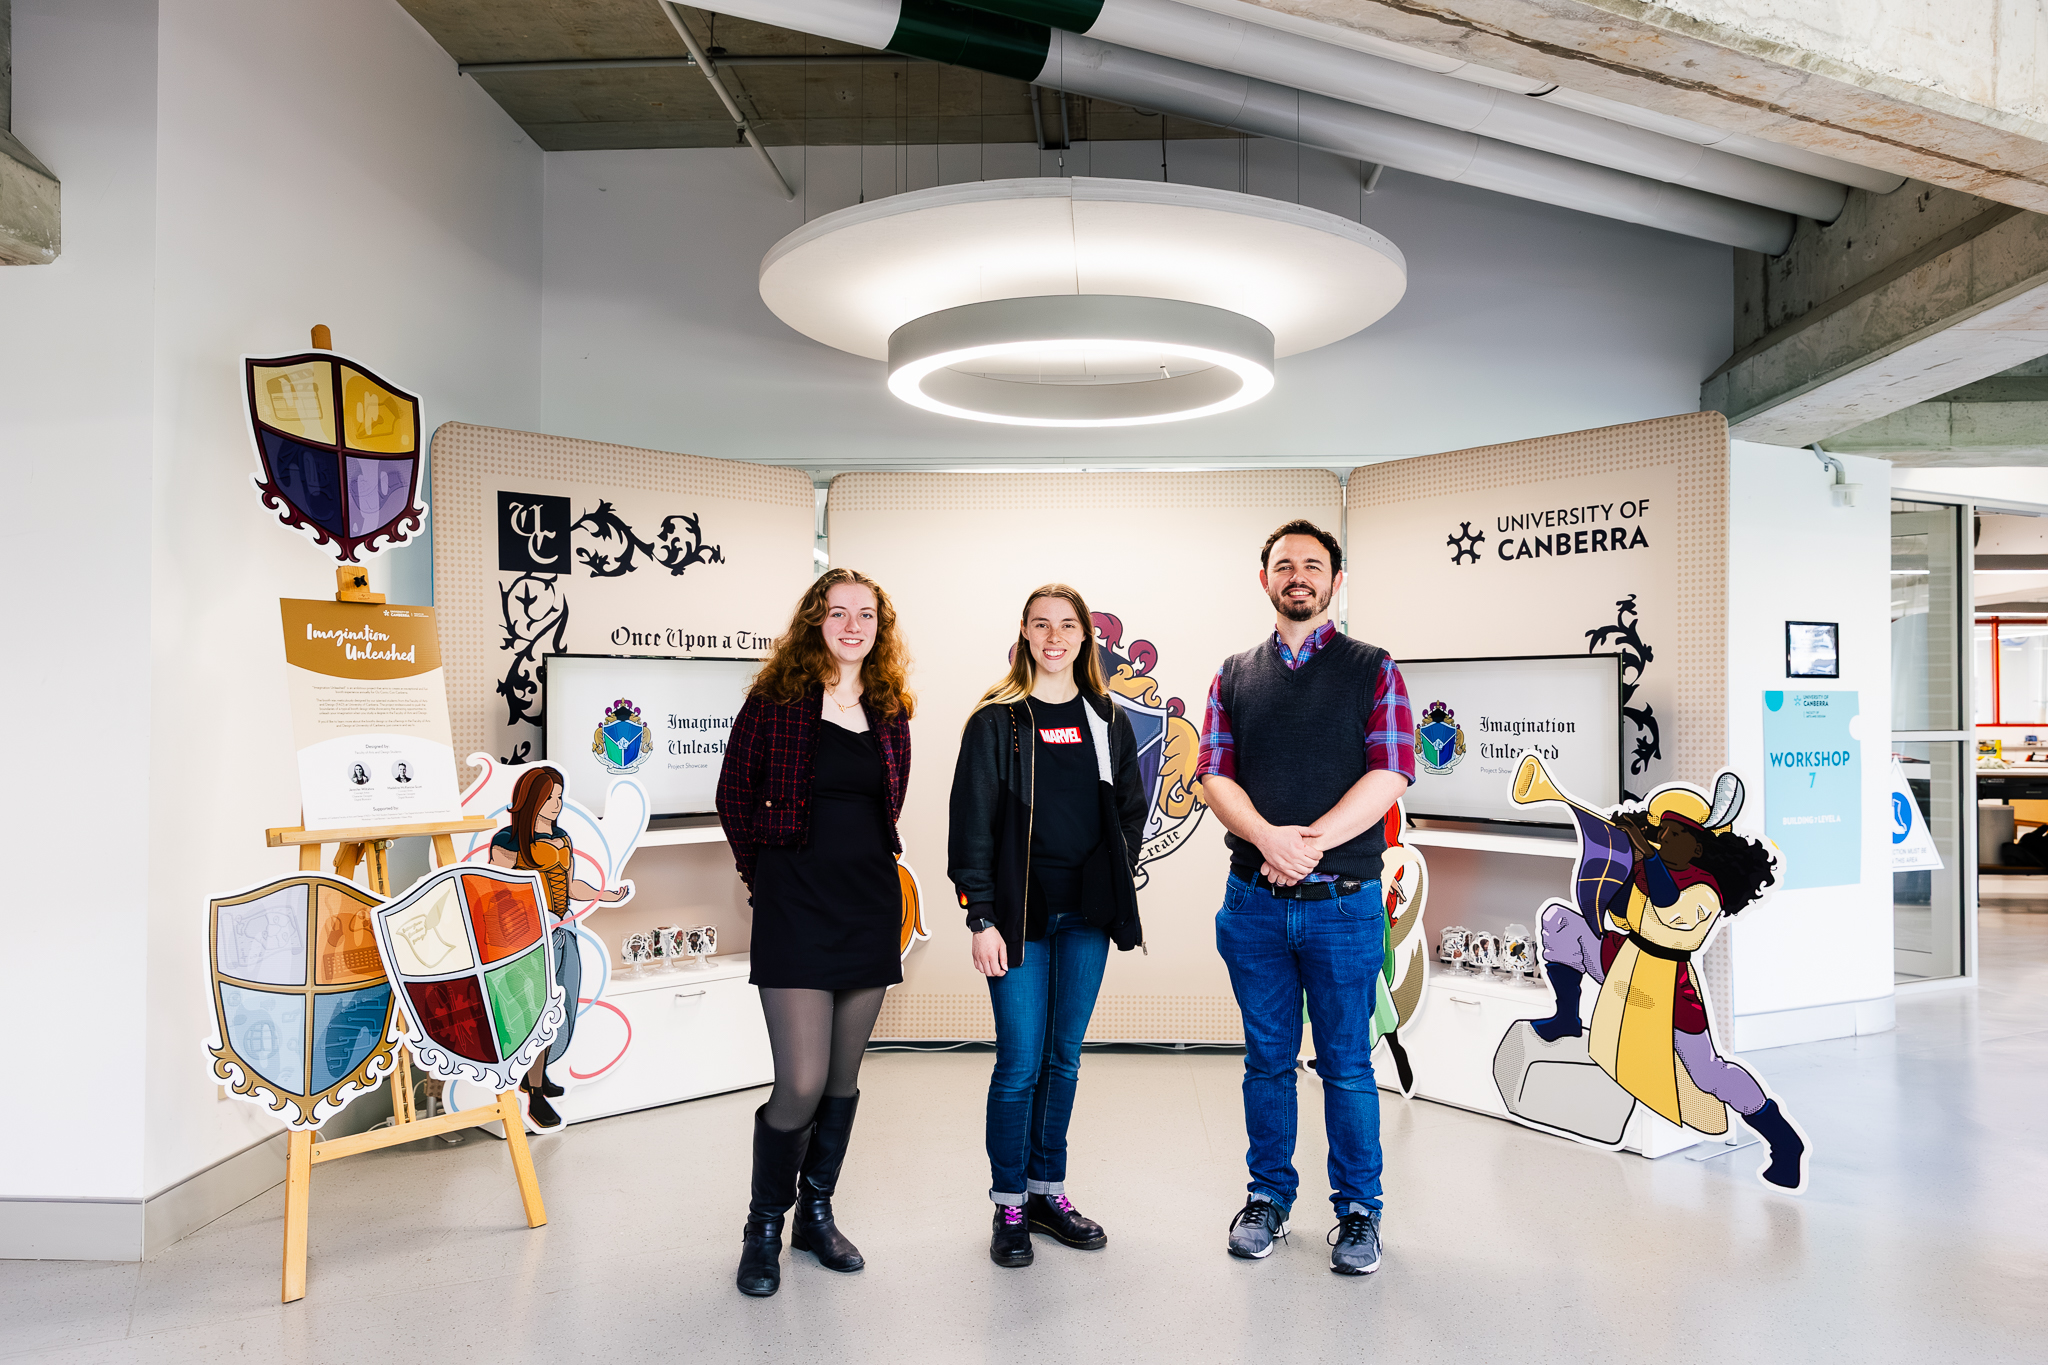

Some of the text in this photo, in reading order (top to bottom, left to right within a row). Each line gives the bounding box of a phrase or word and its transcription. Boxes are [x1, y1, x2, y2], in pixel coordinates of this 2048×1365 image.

[1497, 499, 1650, 533] UNIVERSITY OF
[1497, 525, 1650, 561] CANBERRA
[306, 623, 390, 647] Imagination
[611, 626, 772, 651] Once Upon a Tim
[345, 642, 415, 664] Unleashed
[667, 714, 735, 732] Imaginat
[1480, 716, 1575, 736] Imagination
[1040, 728, 1082, 743] MARVEL
[667, 739, 727, 755] Unleash
[1769, 750, 1850, 768] WORKSHOP
[1480, 767, 1498, 775] Project
[1809, 772, 1816, 788] 7
